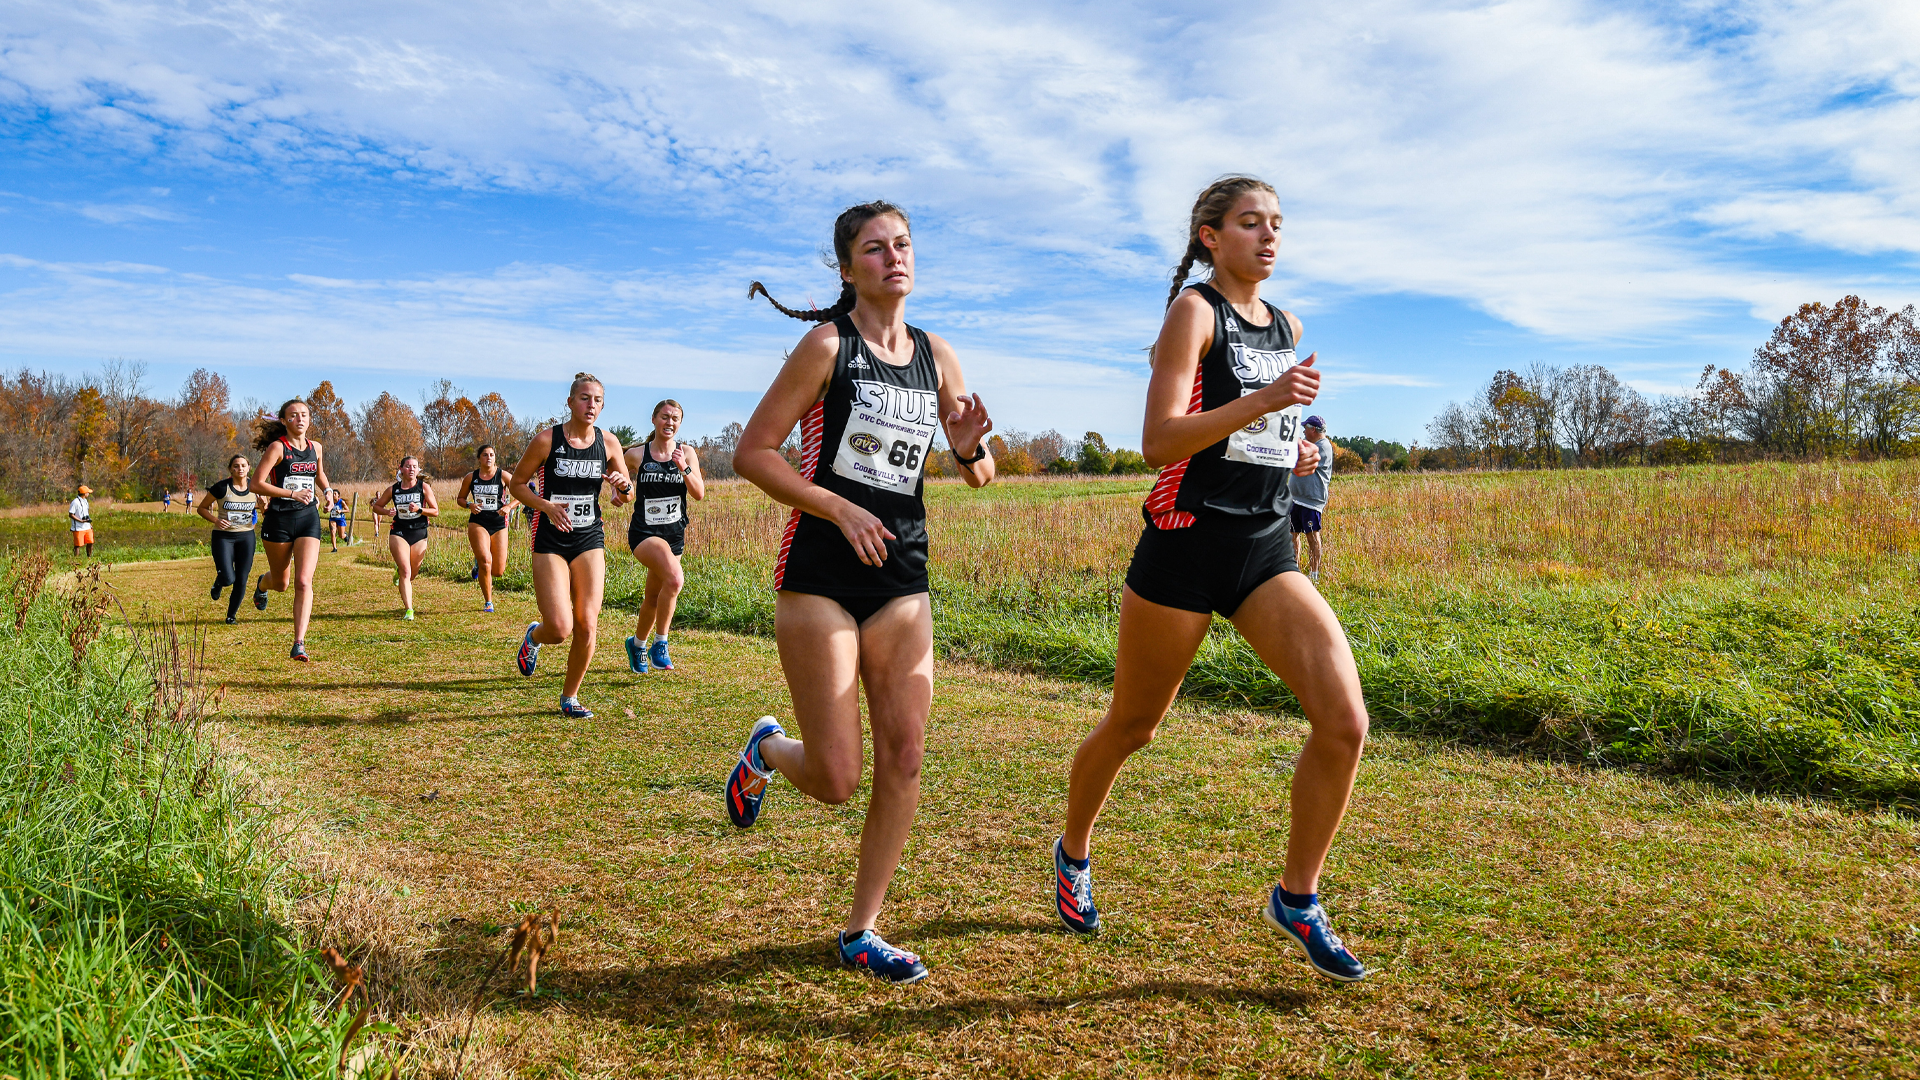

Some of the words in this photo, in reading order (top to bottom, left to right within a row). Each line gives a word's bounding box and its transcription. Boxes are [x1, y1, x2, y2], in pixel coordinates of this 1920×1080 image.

[852, 379, 938, 427] SIUE
[859, 412, 875, 424] OVC
[876, 416, 916, 436] CHAMPIONSHIP
[917, 429, 929, 438] 2022
[1279, 414, 1298, 442] 61
[854, 437, 877, 452] OVC
[887, 439, 921, 471] 66
[291, 461, 317, 473] SEMO
[554, 457, 602, 479] SIUE
[853, 461, 896, 482] COOKEVILLE,
[898, 474, 910, 484] TN
[640, 472, 664, 483] LITTLE
[473, 484, 499, 495] SIUE
[394, 492, 421, 504] SIUE
[573, 503, 592, 517] 58
[666, 503, 678, 515] 12
